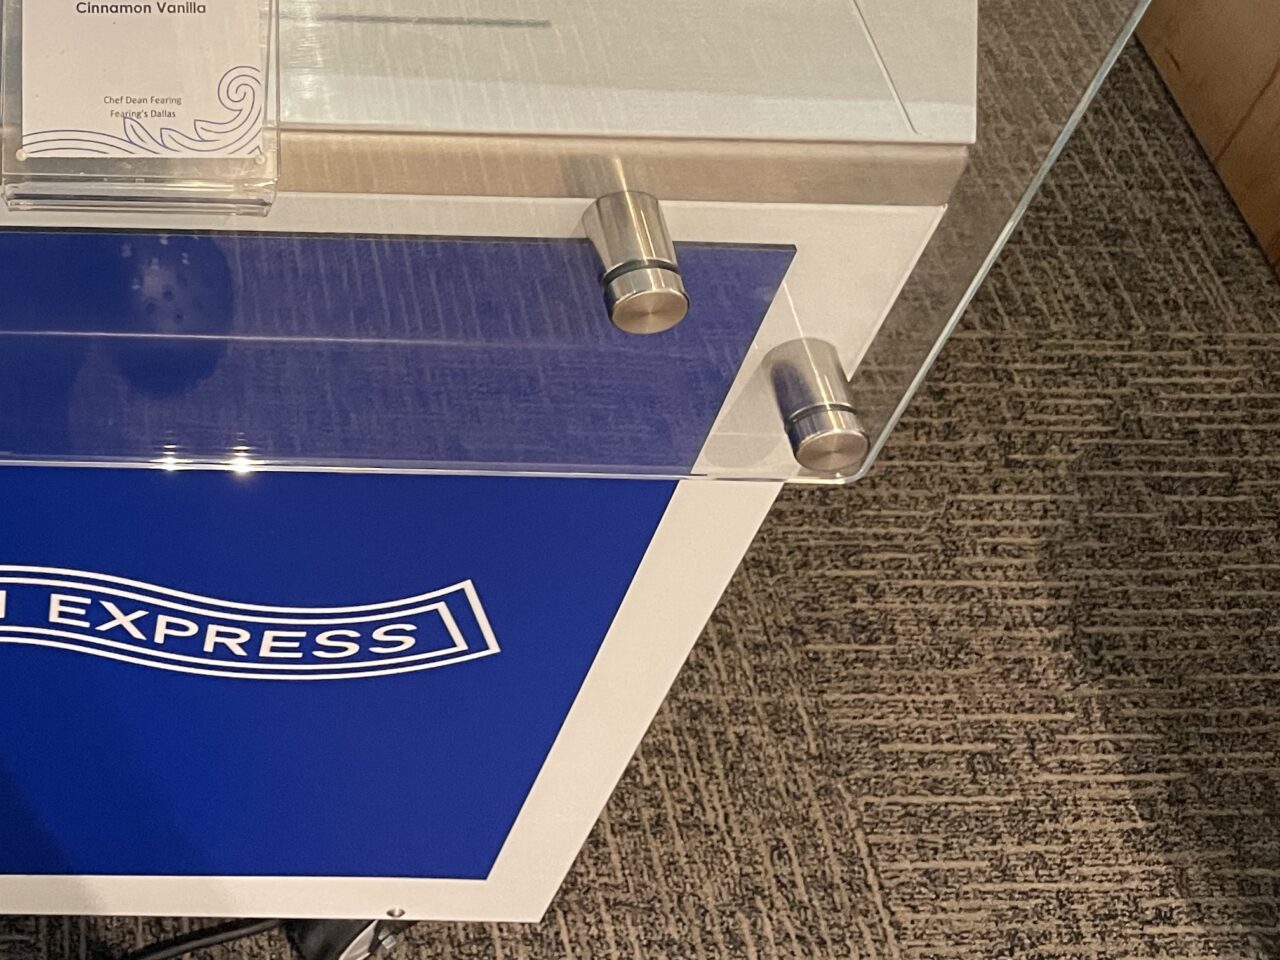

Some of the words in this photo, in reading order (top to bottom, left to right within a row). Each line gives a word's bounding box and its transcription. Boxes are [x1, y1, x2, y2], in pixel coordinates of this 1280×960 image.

[76, 1, 152, 14] Cinnamon
[156, 1, 207, 14] Vanilla
[103, 96, 124, 105] Chef
[125, 96, 148, 105] Dean
[150, 96, 182, 106] Fearing
[110, 109, 148, 119] Fearing's
[150, 109, 176, 118] Dallas
[48, 592, 418, 658] EXPRESS
